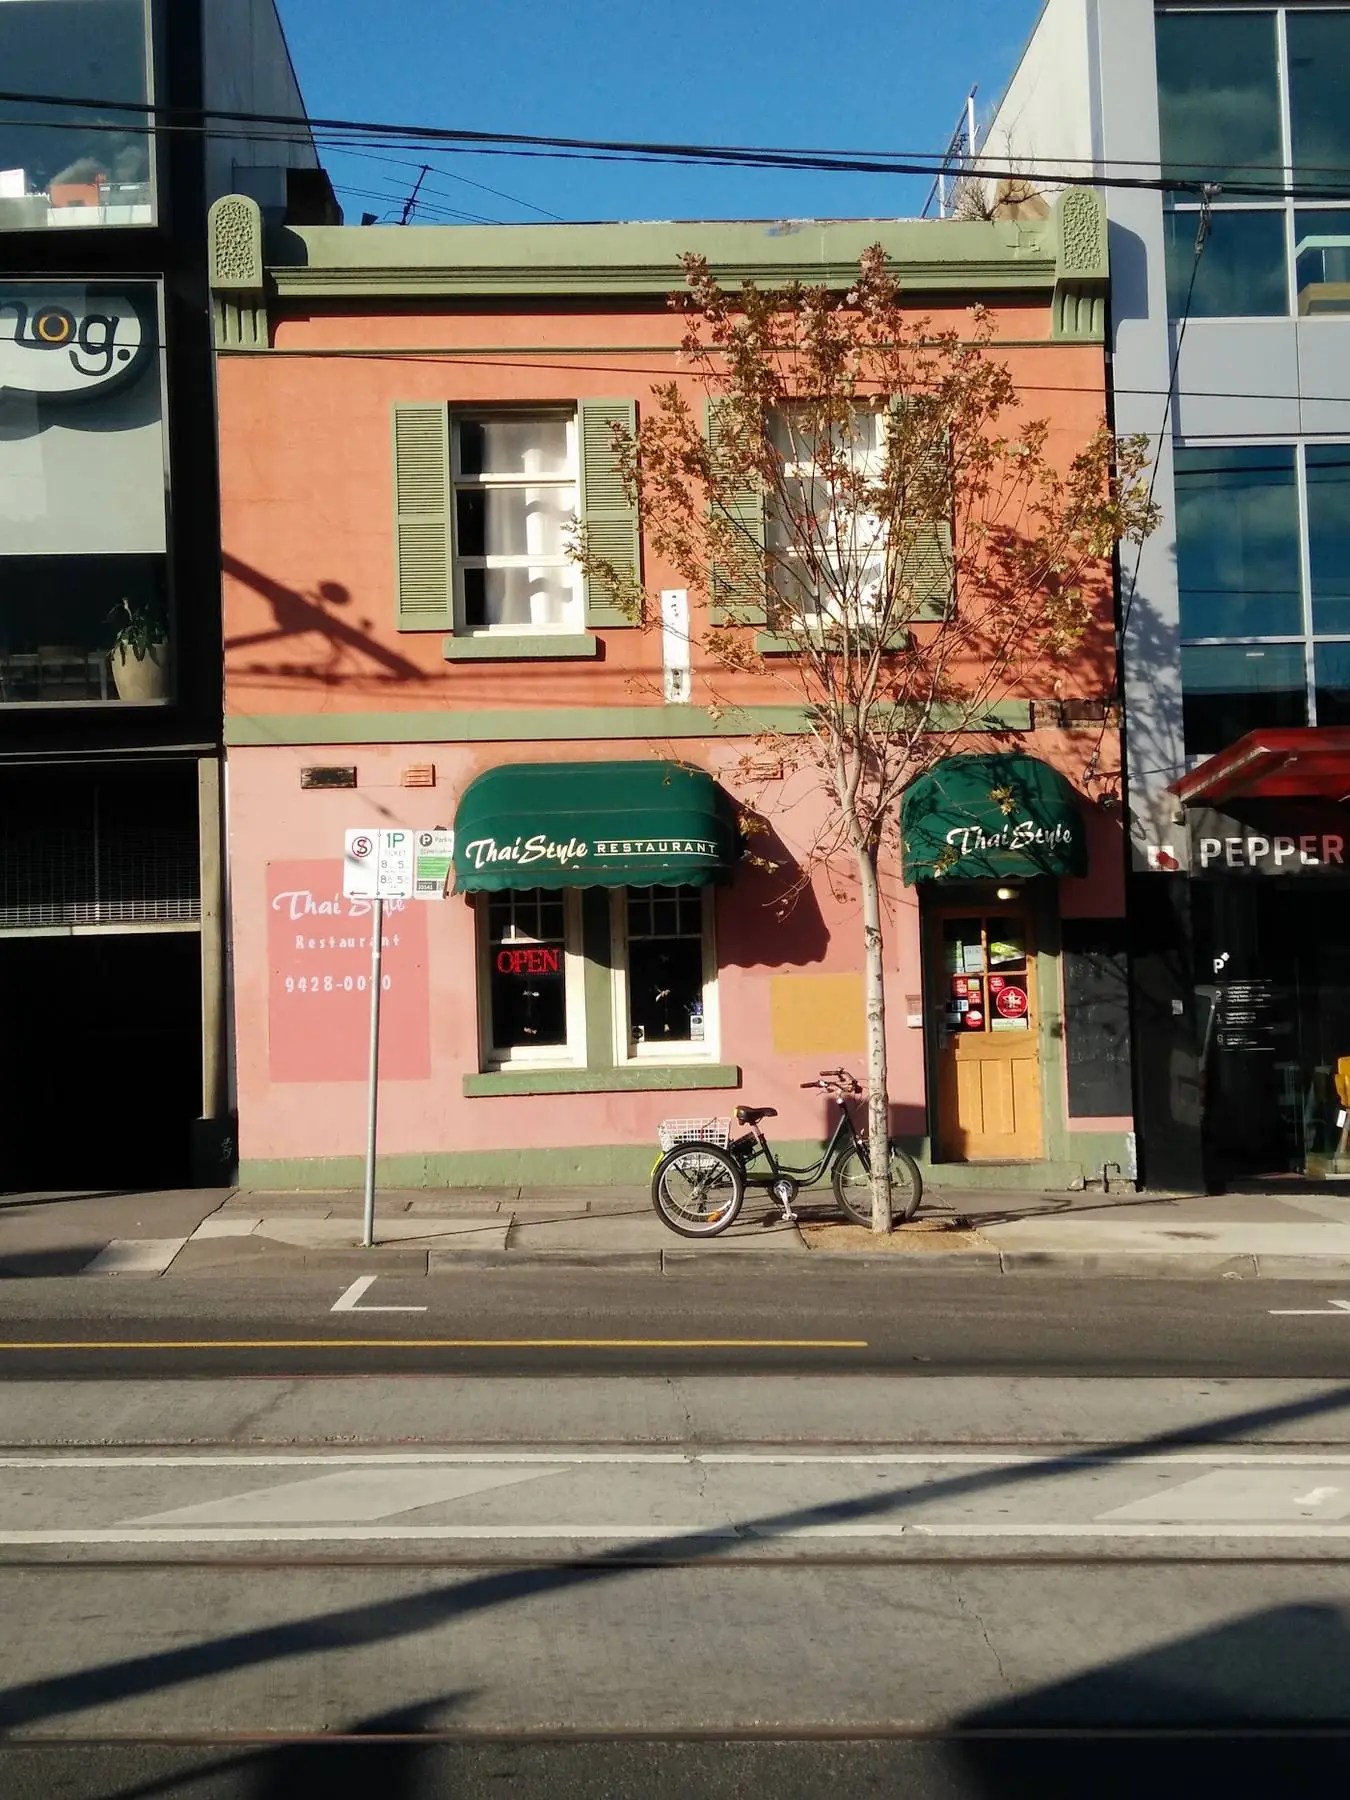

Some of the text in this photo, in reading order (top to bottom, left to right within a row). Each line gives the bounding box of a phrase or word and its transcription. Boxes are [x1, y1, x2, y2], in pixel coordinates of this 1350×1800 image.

[387, 832, 405, 849] 1P
[465, 836, 521, 869] Thai
[517, 835, 588, 864] Style
[597, 841, 717, 854] RESTAURANT
[946, 820, 1073, 855] Thai Style
[1200, 834, 1344, 868] PEPPER
[272, 890, 342, 921] Thai
[496, 947, 560, 974] OPEN
[284, 974, 391, 993] 9428-000
